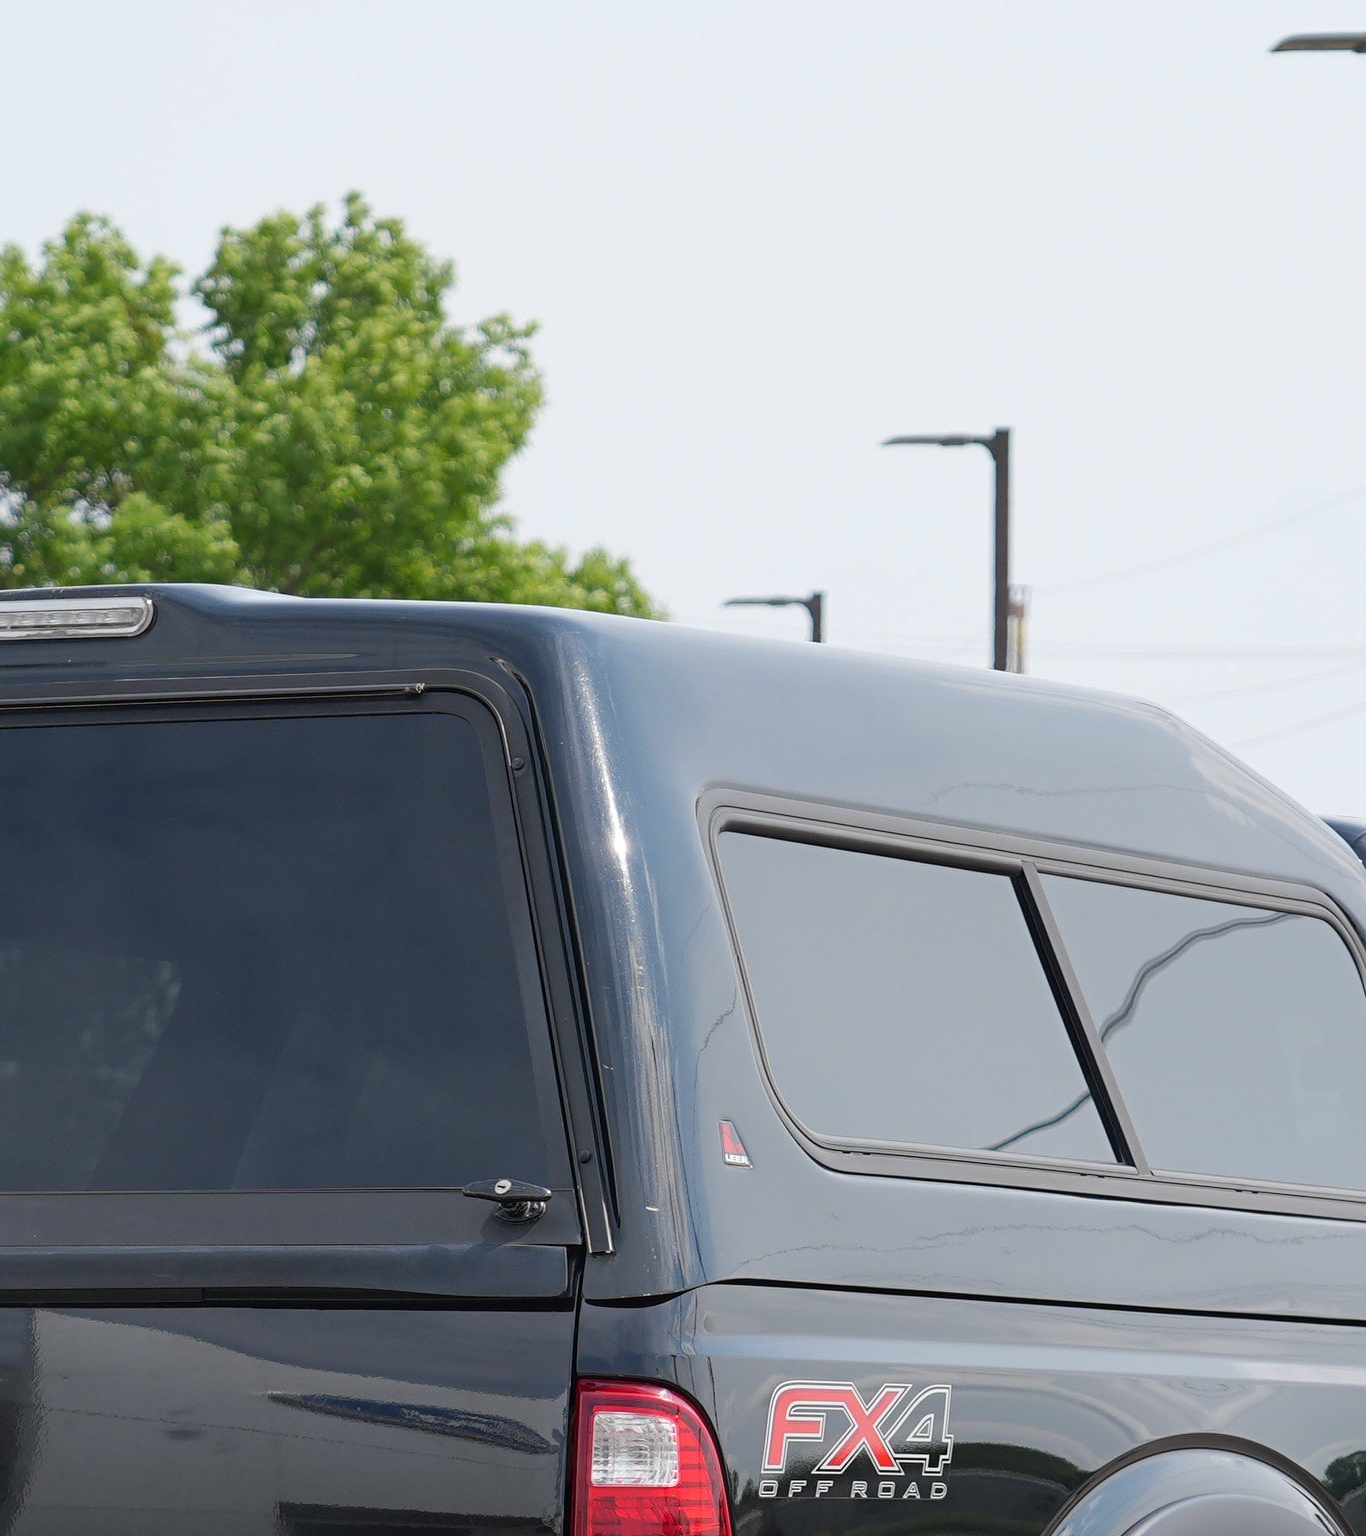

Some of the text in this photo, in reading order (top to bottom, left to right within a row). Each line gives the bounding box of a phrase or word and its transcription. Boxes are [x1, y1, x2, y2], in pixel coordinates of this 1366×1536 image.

[725, 1154, 749, 1164] LEER
[761, 1380, 954, 1476] FX4
[759, 1480, 948, 1499] OFF ROAD
